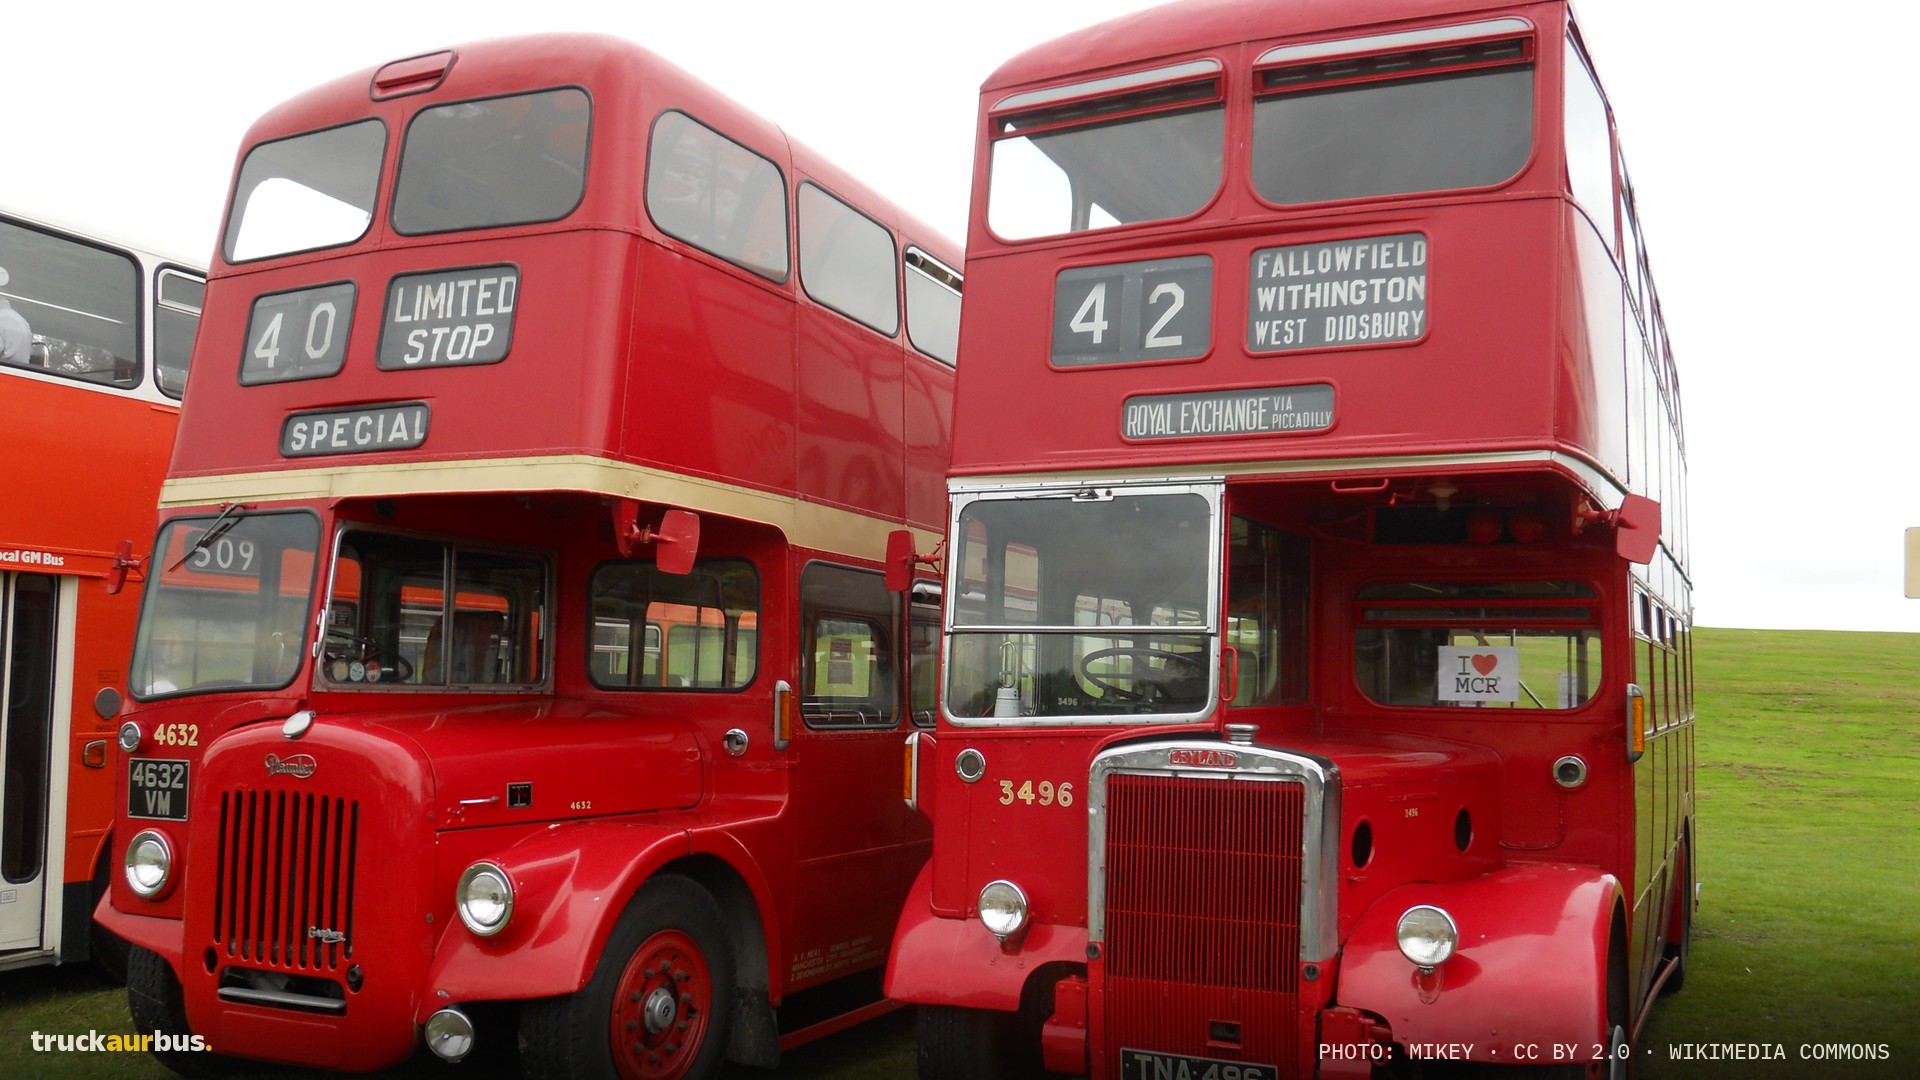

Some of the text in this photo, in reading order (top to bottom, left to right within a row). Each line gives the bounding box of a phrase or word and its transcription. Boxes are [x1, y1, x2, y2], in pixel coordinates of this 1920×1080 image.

[1257, 240, 1427, 278] FALLOWFIELD
[394, 276, 517, 322] LIMITED
[1257, 275, 1426, 312] WITHINGTON
[1069, 282, 1185, 349] 42
[1255, 310, 1424, 346] WEST DIDSBURY
[254, 302, 337, 368] 40
[403, 323, 495, 365] STOP
[1127, 397, 1270, 436] ROYAL EXCHANGE
[1273, 396, 1293, 411] VIA
[291, 411, 425, 451] SPECIAL
[1272, 411, 1332, 429] PICCADILLY
[21, 550, 41, 564] GM
[43, 552, 65, 566] Bus
[1458, 656, 1470, 675] I
[1455, 677, 1499, 693] MCR
[1058, 697, 1078, 706] 3496
[154, 723, 199, 746] 4632
[1171, 750, 1235, 766] LEYLAND
[132, 762, 184, 789] 4632
[145, 790, 171, 816] VM
[570, 801, 592, 810] 4632
[999, 780, 1073, 807] 3496
[1134, 1054, 1191, 1080] TNA
